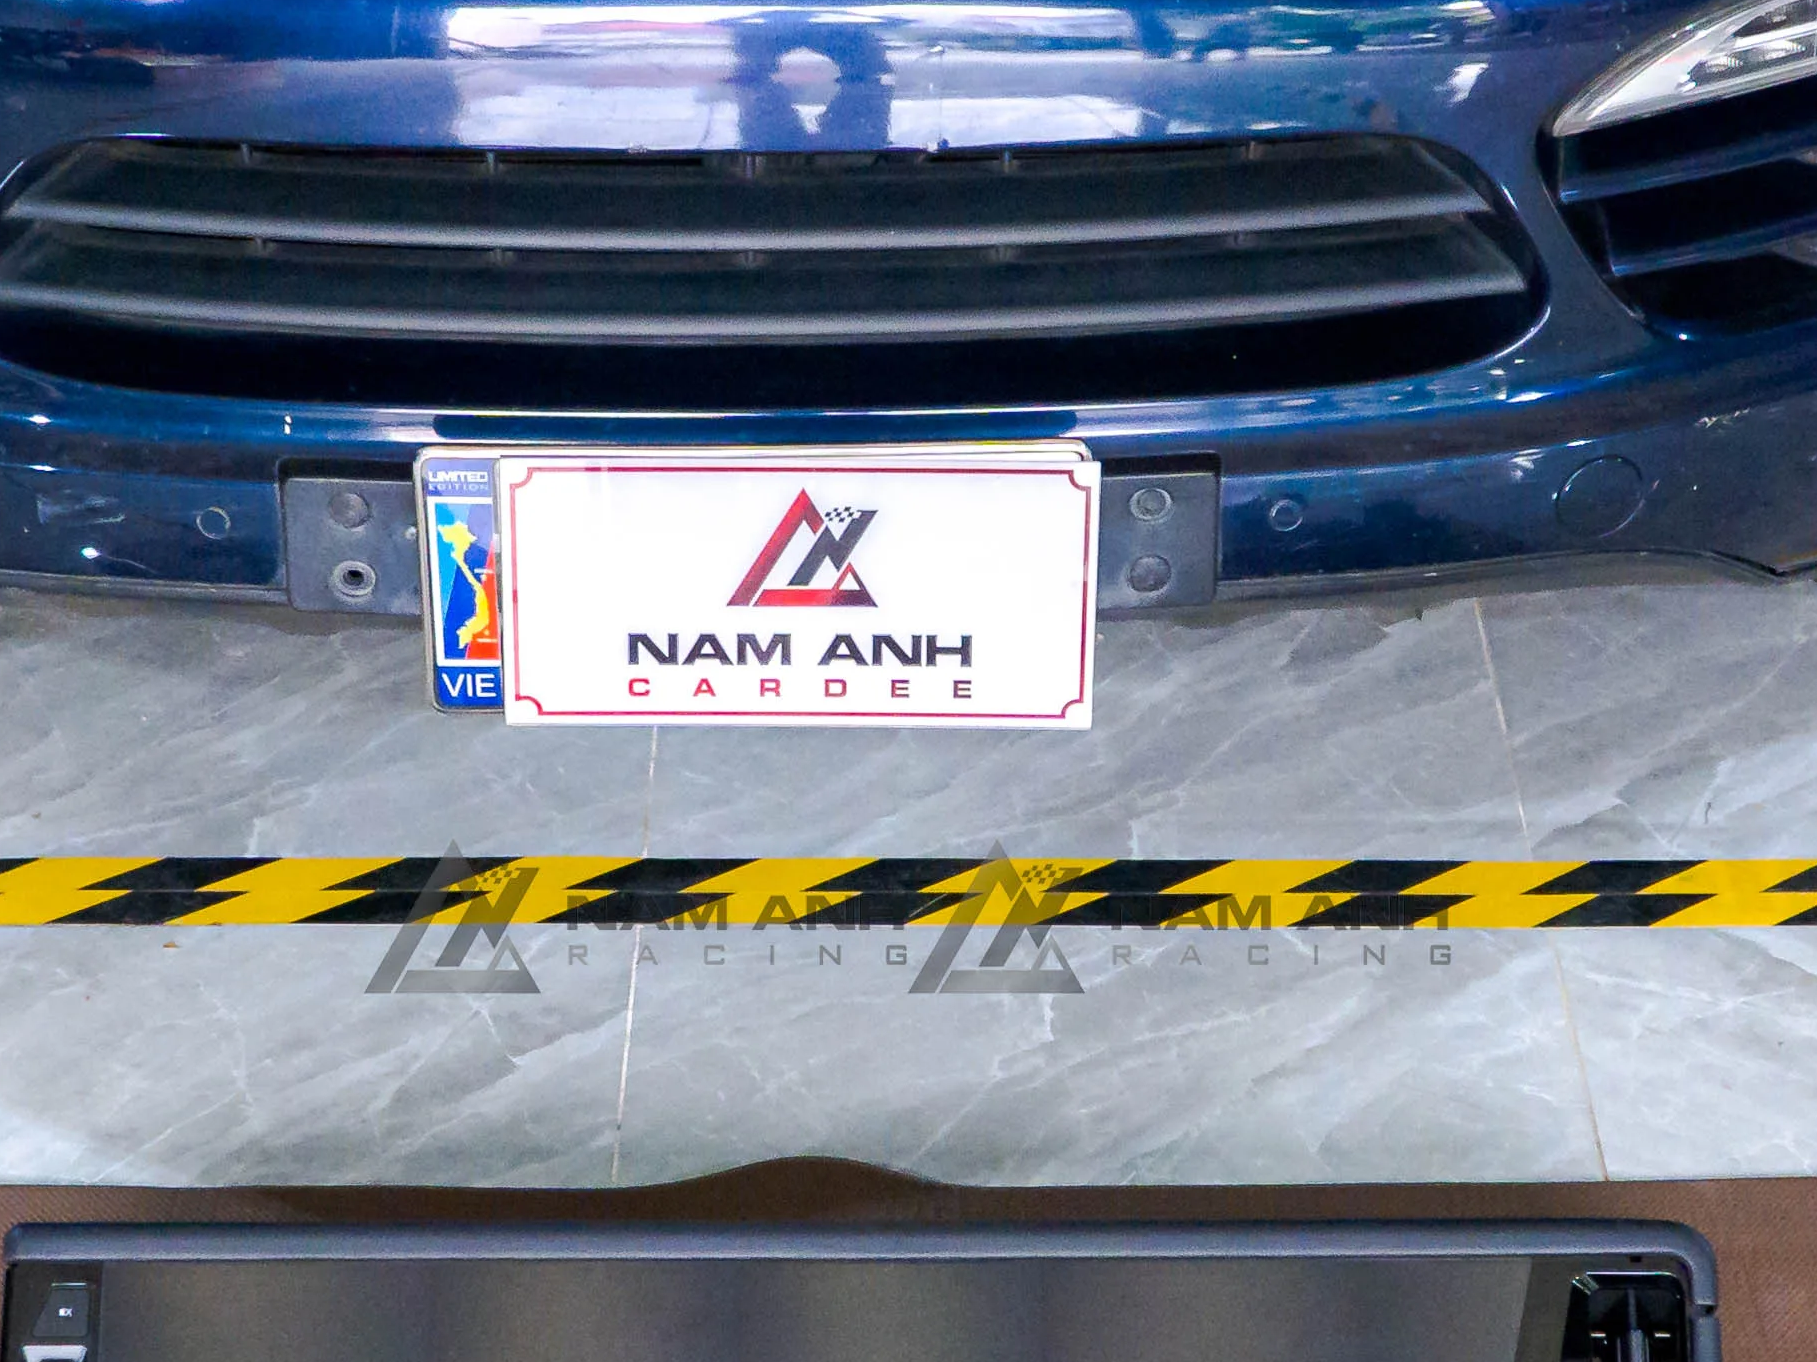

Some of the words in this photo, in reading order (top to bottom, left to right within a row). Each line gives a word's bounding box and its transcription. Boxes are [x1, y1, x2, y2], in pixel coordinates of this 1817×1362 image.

[427, 470, 489, 483] LIMITED
[627, 633, 792, 666] NAM
[817, 633, 973, 667] ANH
[441, 672, 498, 698] VIE
[627, 677, 973, 699] CARDEE
